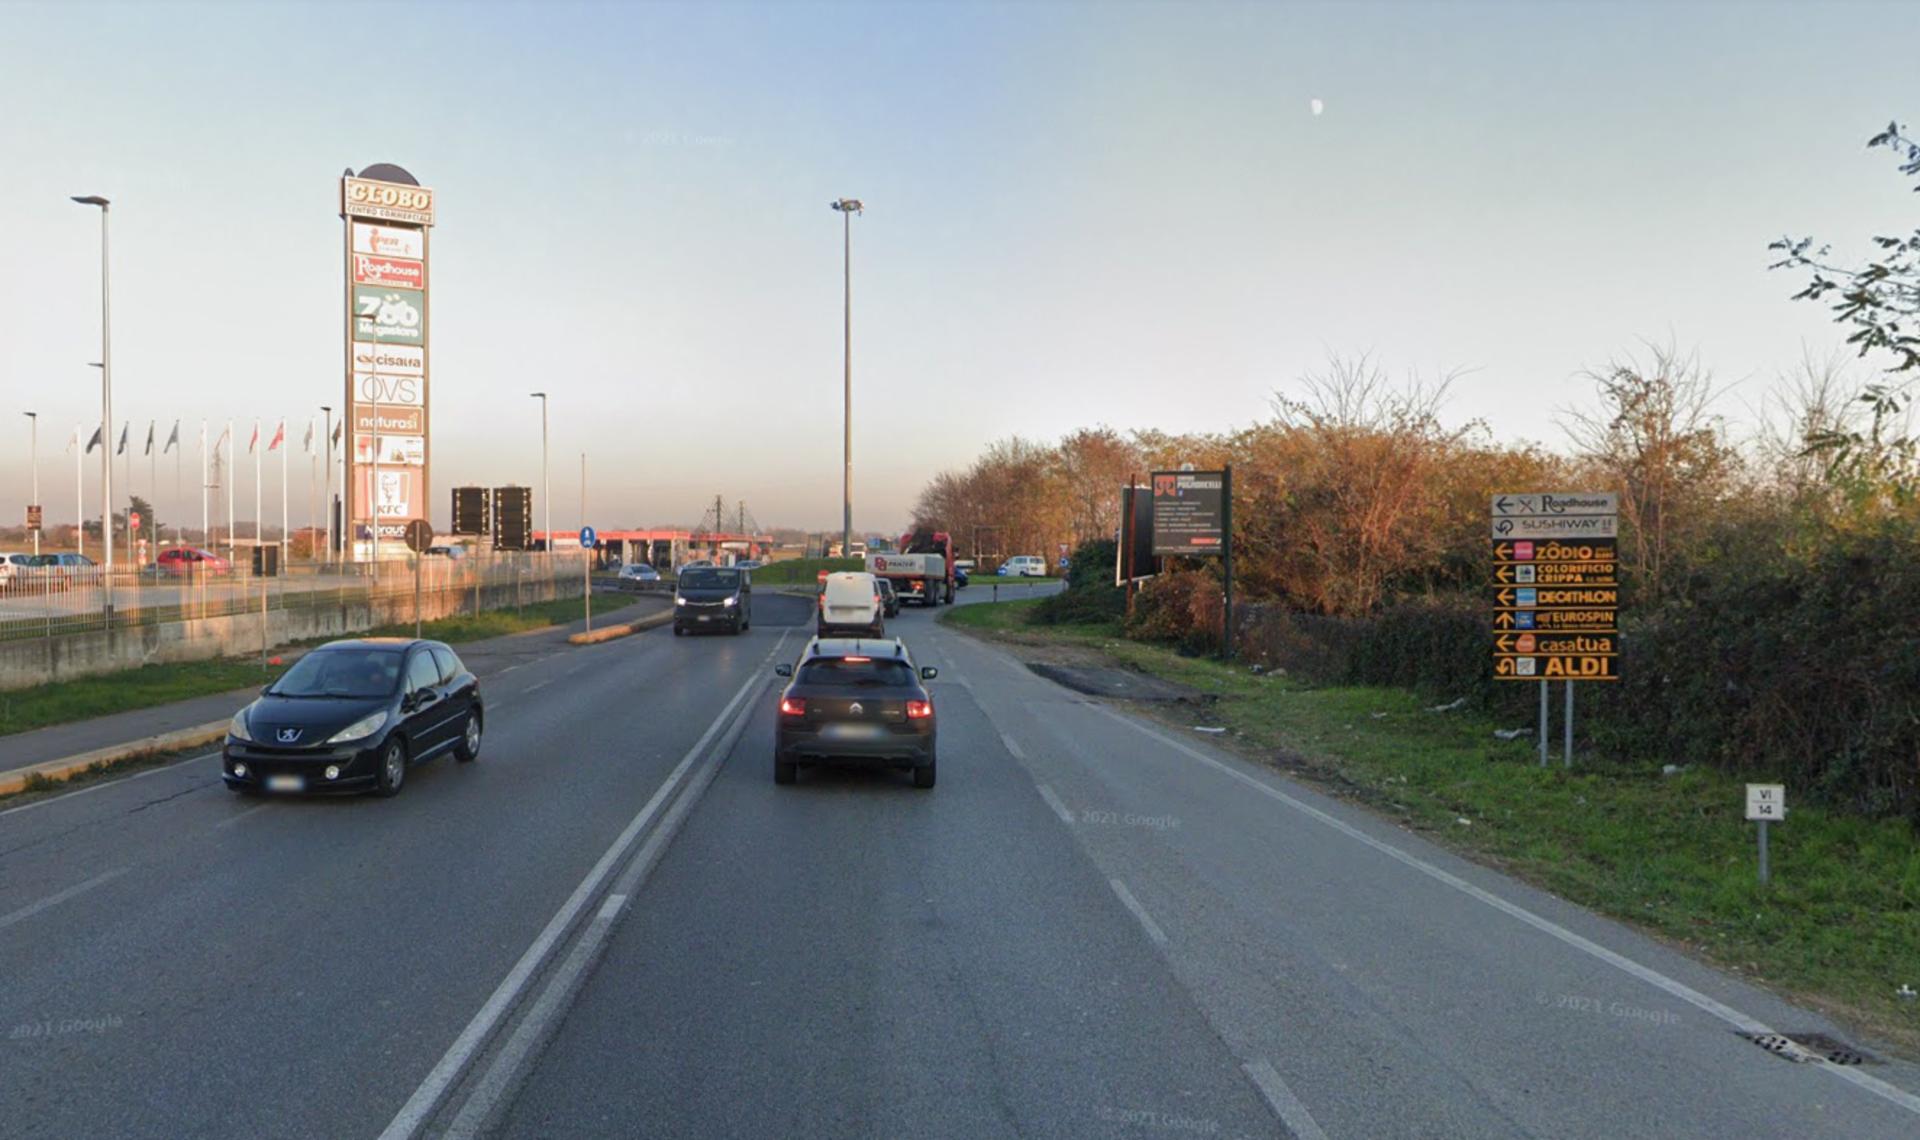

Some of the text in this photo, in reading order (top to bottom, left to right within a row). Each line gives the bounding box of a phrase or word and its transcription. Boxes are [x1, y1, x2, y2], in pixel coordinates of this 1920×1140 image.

[351, 183, 430, 210] GLOBO
[357, 255, 420, 281] Roadhouse
[362, 376, 416, 403] OVS
[377, 505, 402, 515] KFC
[1541, 495, 1608, 514] Roadhouse
[1522, 519, 1598, 530] SUSHIWAY
[1537, 564, 1614, 574] COLORIFICIO
[1537, 574, 1583, 583] CRIPPA
[1538, 591, 1617, 603] DECATHLON
[1552, 611, 1614, 622] EUROSPIN
[1540, 636, 1611, 652] casatua
[1545, 657, 1608, 675] ALDI
